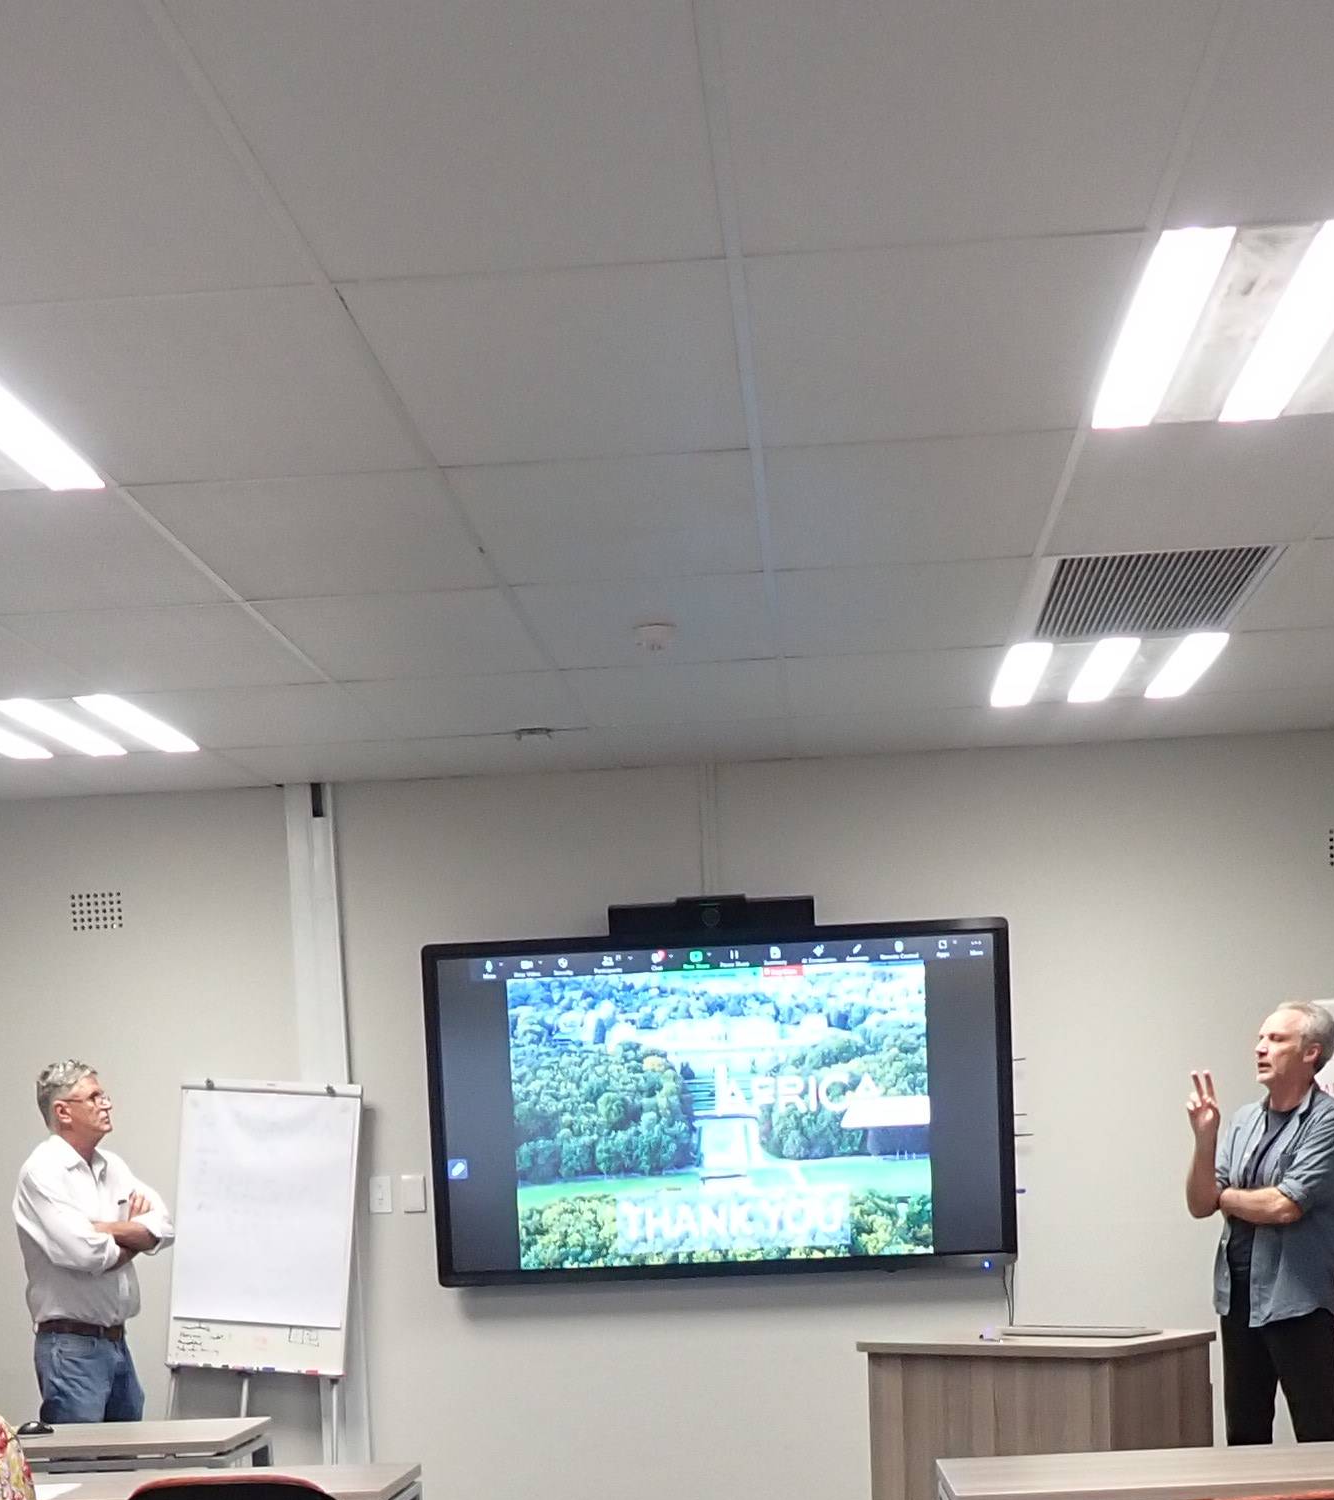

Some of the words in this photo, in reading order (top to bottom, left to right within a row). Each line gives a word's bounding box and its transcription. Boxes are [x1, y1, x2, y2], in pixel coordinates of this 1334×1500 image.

[714, 1068, 883, 1121] AFRICA
[620, 1199, 753, 1241] THANK
[760, 1195, 844, 1234] YOU
